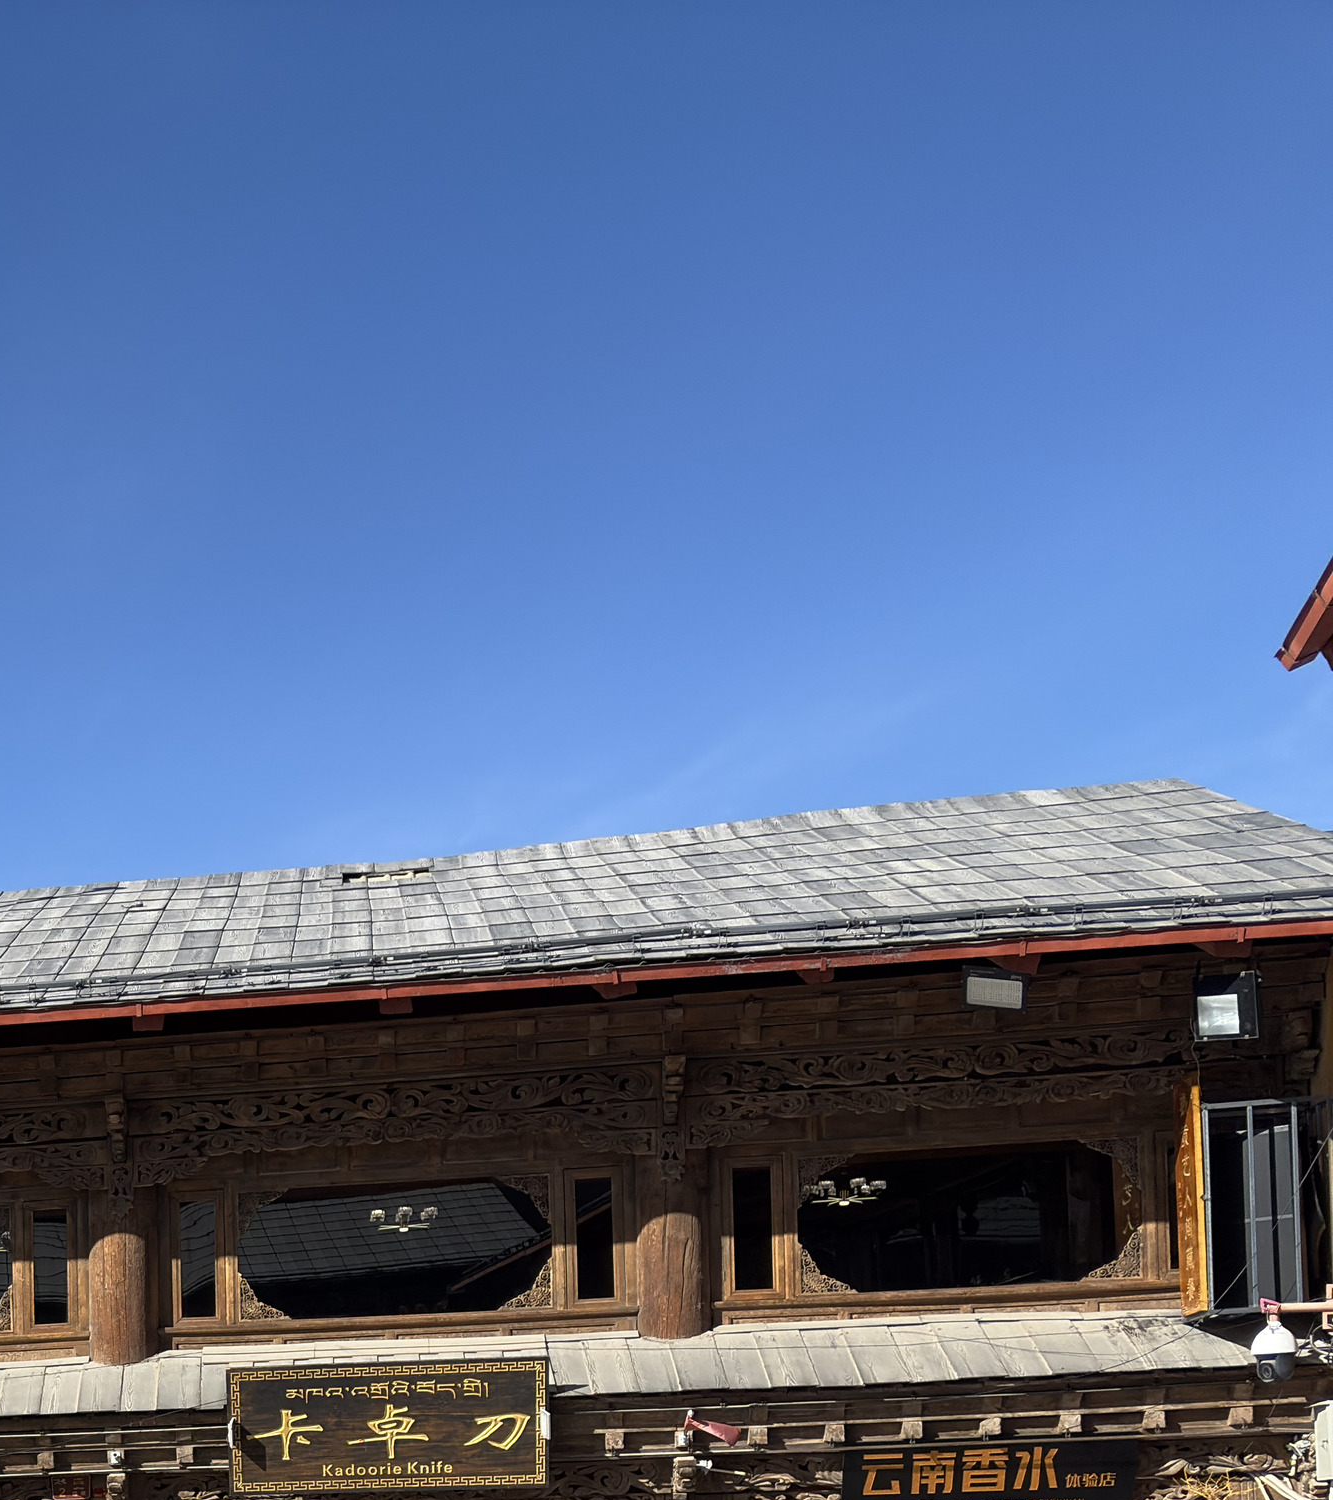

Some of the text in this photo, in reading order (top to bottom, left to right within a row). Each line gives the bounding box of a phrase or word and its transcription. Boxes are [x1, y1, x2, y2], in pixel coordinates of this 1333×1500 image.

[246, 1404, 531, 1460] 卡卓刀
[322, 1461, 454, 1477] Kadoorie Knife
[862, 1446, 1116, 1496] 云南香水 体验店
